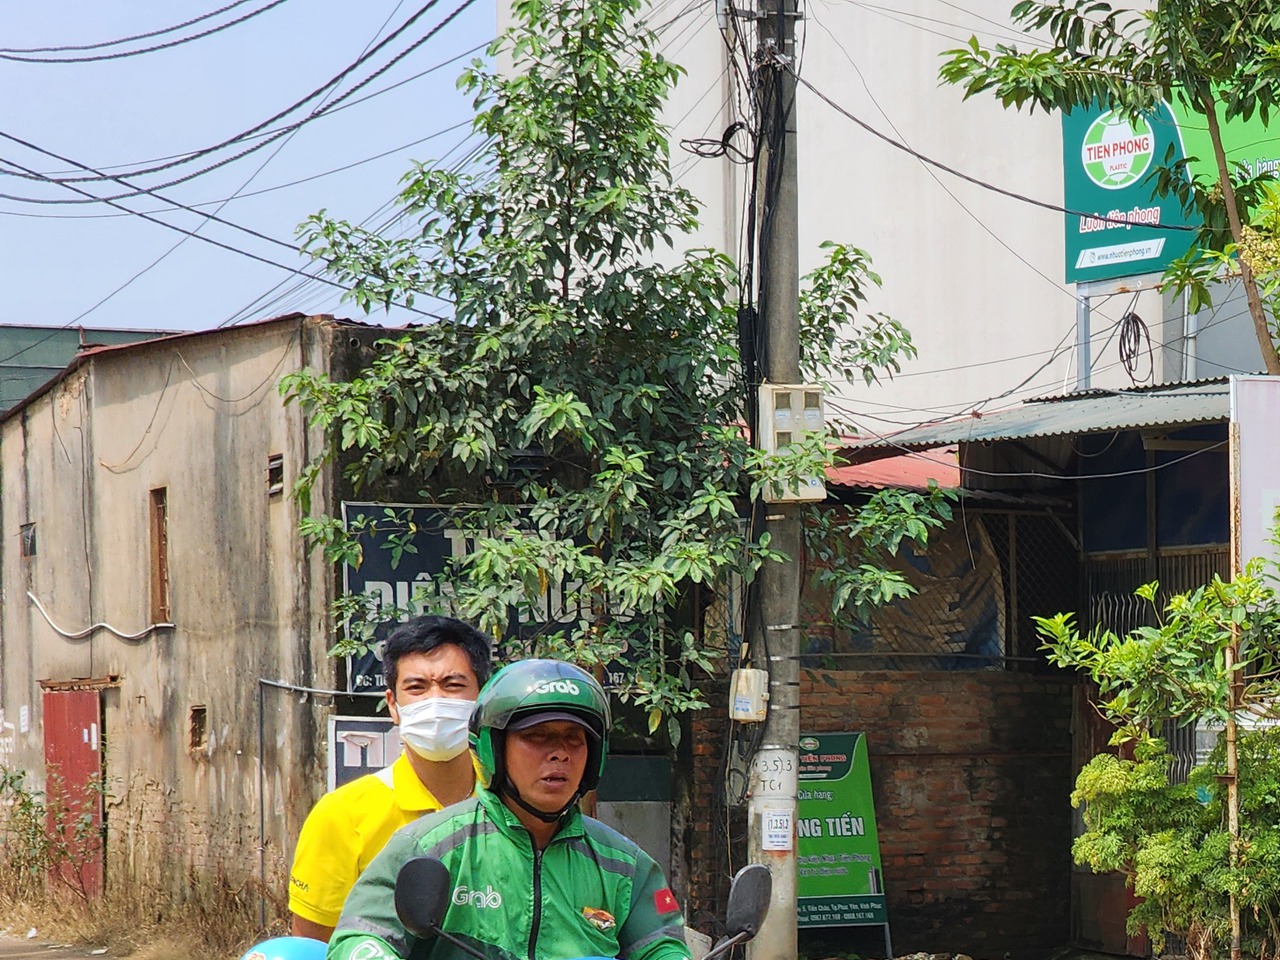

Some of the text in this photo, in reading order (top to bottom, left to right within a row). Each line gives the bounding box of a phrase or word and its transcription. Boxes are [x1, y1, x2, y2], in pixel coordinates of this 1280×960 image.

[1087, 137, 1149, 161] TIEN PHONG
[533, 679, 580, 696] Grab
[825, 811, 865, 836] TIẾN
[453, 884, 502, 909] Grab
